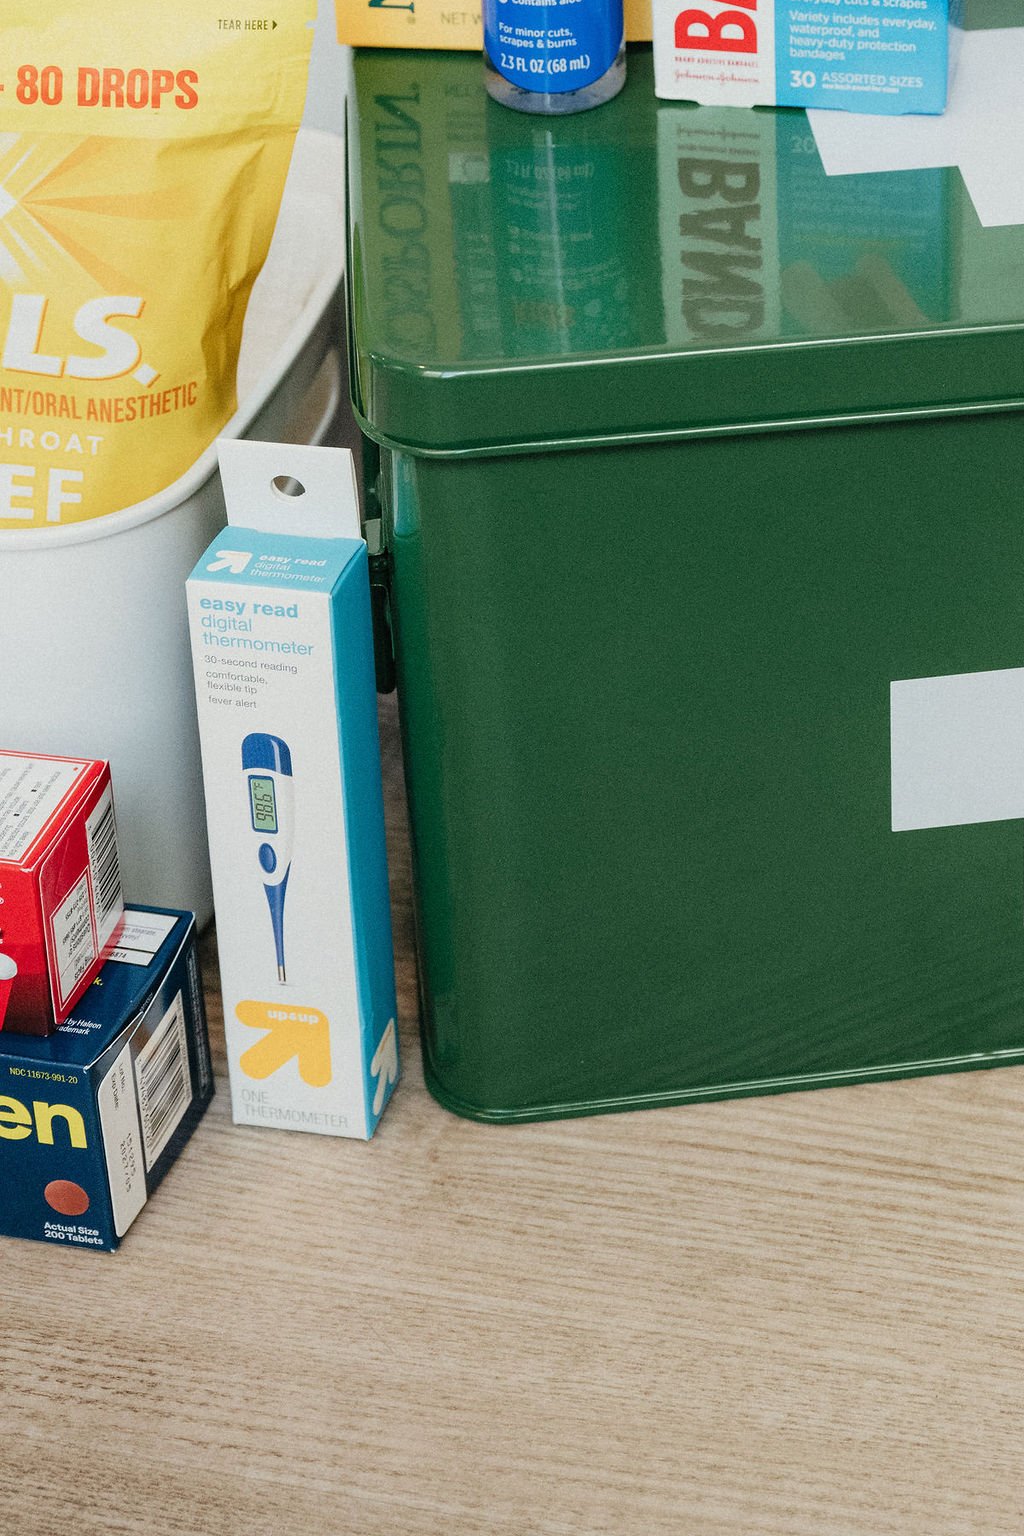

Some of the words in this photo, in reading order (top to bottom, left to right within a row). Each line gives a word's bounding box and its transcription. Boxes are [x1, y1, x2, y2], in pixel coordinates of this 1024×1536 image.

[883, 0, 927, 9] scrapes
[218, 20, 240, 30] TEAR
[244, 20, 268, 30] HERE
[16, 64, 62, 105] 80
[78, 67, 198, 109] DROPS
[790, 70, 816, 88] 30
[822, 72, 886, 86] ASSORTED
[889, 75, 923, 88] SIZES
[87, 382, 197, 423] ANESTHETIC
[200, 599, 246, 616] easy
[253, 602, 298, 618] read
[201, 615, 252, 633] digital
[203, 633, 314, 656] thermometer
[204, 655, 257, 668] 30-second
[260, 662, 298, 674] reading
[206, 671, 268, 685] comfortable,
[207, 682, 241, 692] flexible
[245, 685, 257, 694] tip
[209, 697, 232, 706] fever
[236, 698, 256, 708] alert
[10, 1067, 26, 1077] NDC
[27, 1070, 78, 1084] 11673-991-20
[44, 1222, 77, 1234] Actual
[78, 1226, 99, 1236] Size
[44, 1230, 65, 1240] 200
[67, 1233, 103, 1245] Tablets
